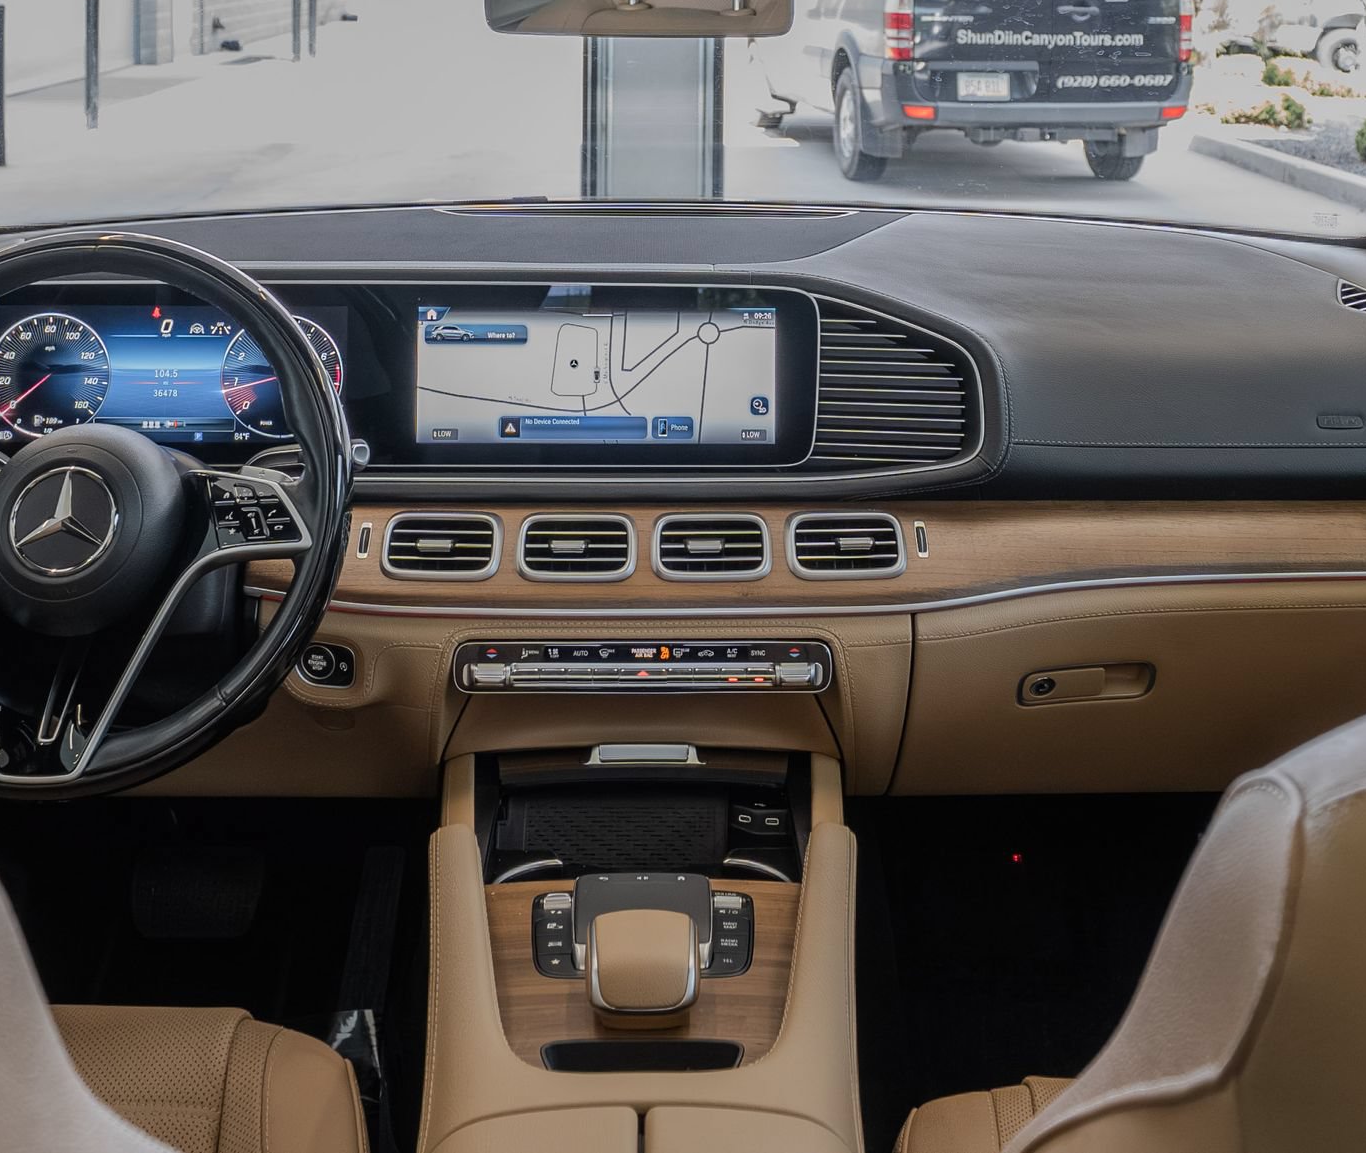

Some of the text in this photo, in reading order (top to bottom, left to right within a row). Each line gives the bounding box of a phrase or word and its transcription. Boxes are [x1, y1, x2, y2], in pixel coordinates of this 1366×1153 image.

[956, 29, 1143, 48] ShunDiinCanyonTours.com
[1056, 75, 1098, 88] (928)
[161, 319, 173, 333] 0
[242, 401, 250, 410] 0
